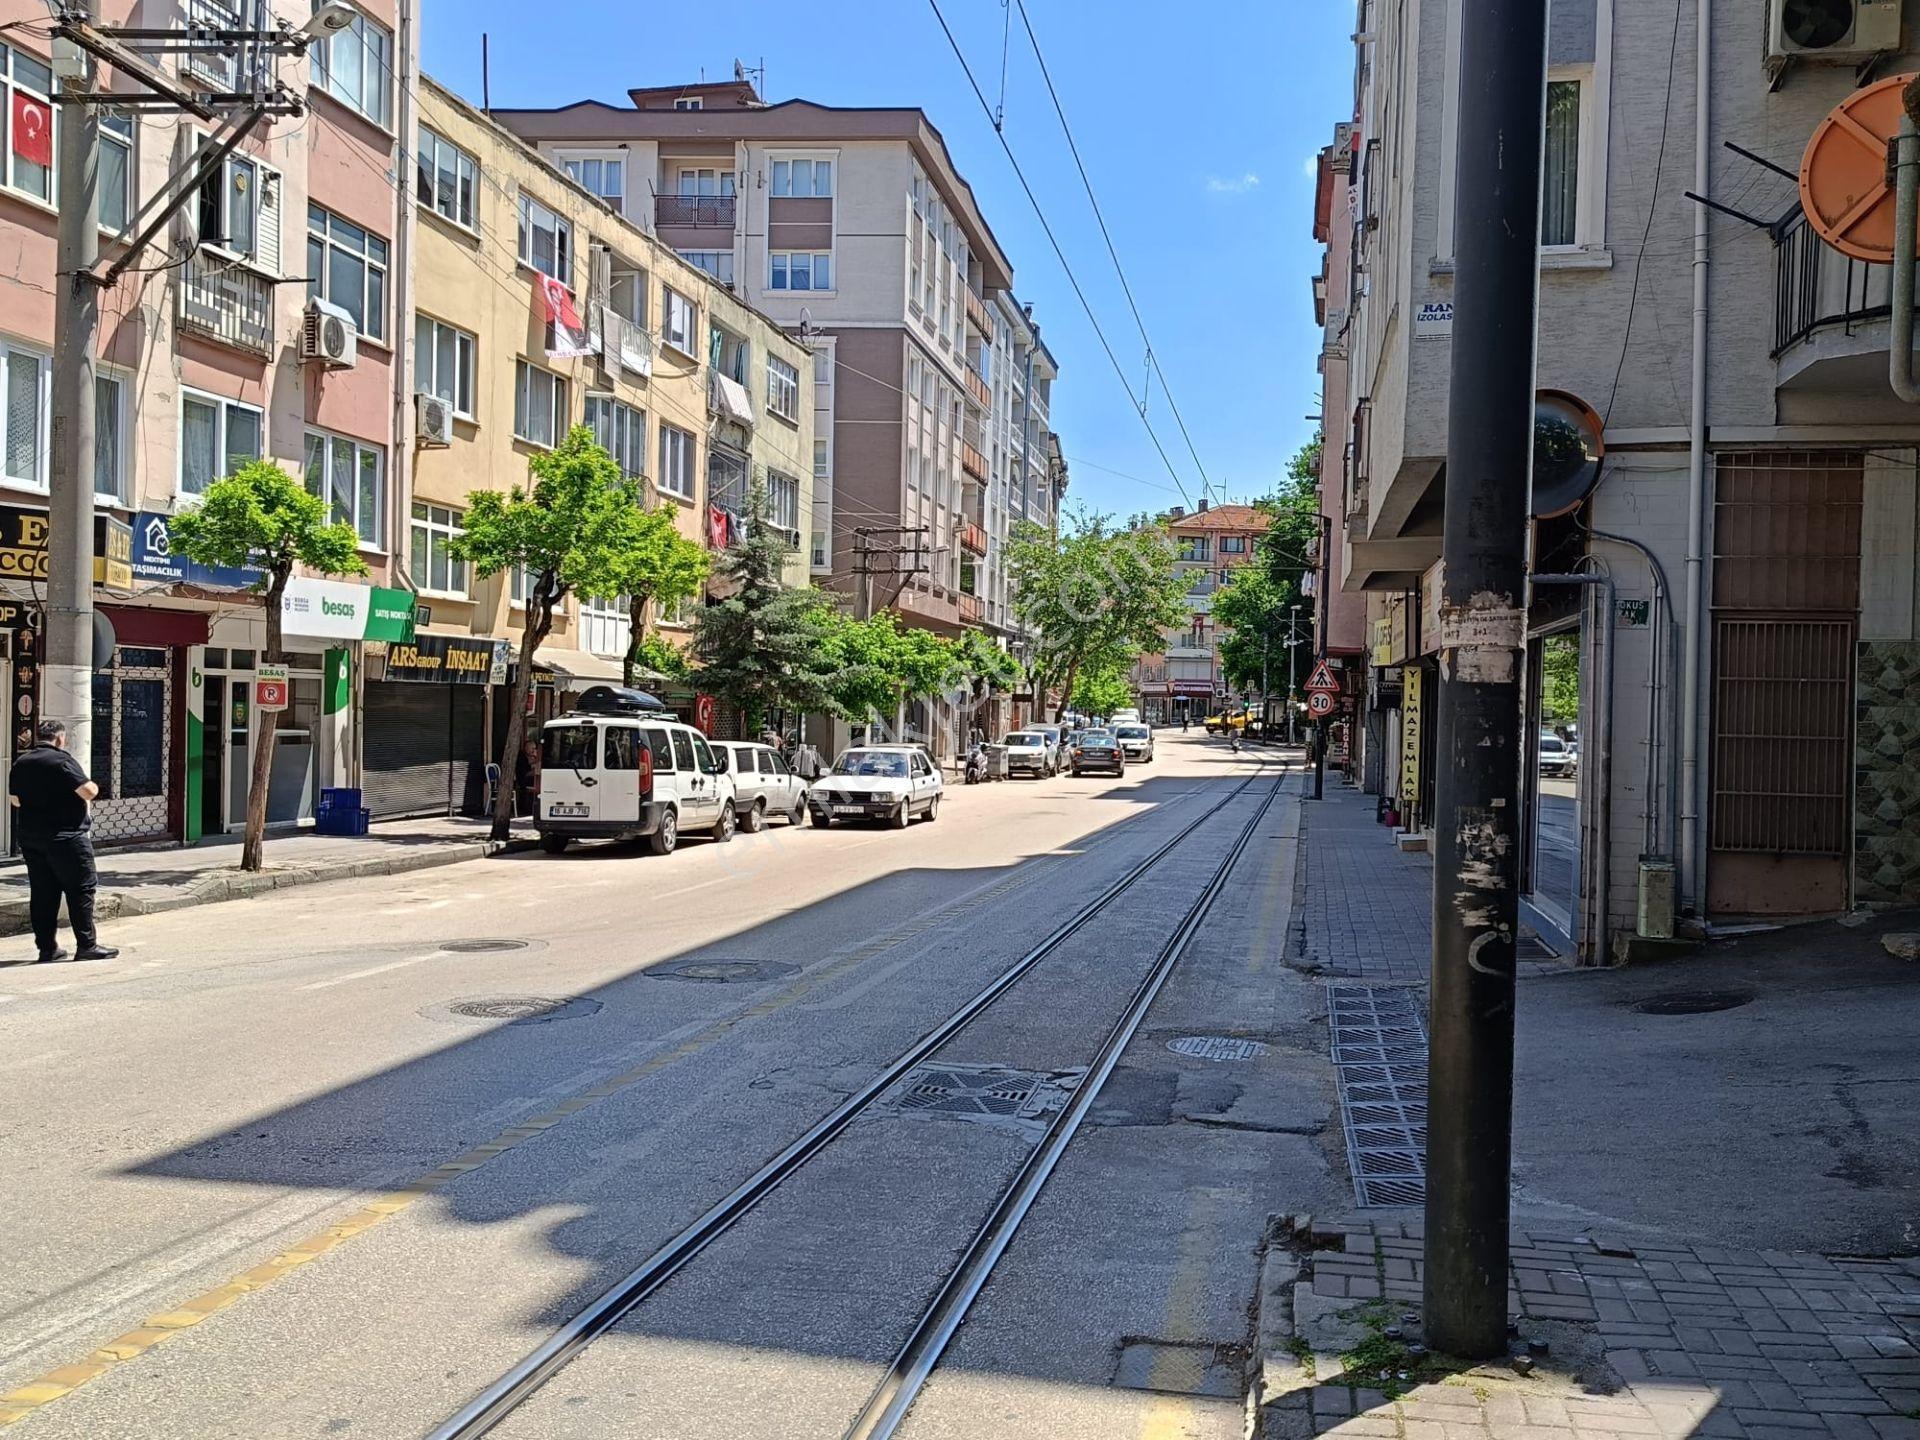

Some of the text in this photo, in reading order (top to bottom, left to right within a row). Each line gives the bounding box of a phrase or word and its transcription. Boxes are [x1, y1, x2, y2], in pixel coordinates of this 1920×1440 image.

[132, 563, 183, 577] TAŞIMACILIK
[322, 596, 355, 620] besaş
[389, 645, 418, 667] ARS
[417, 656, 441, 668] GROUP
[446, 645, 489, 675] İNŞAAT
[1312, 697, 1328, 709] 30
[1404, 670, 1418, 797] YILMAZ EMLAK
